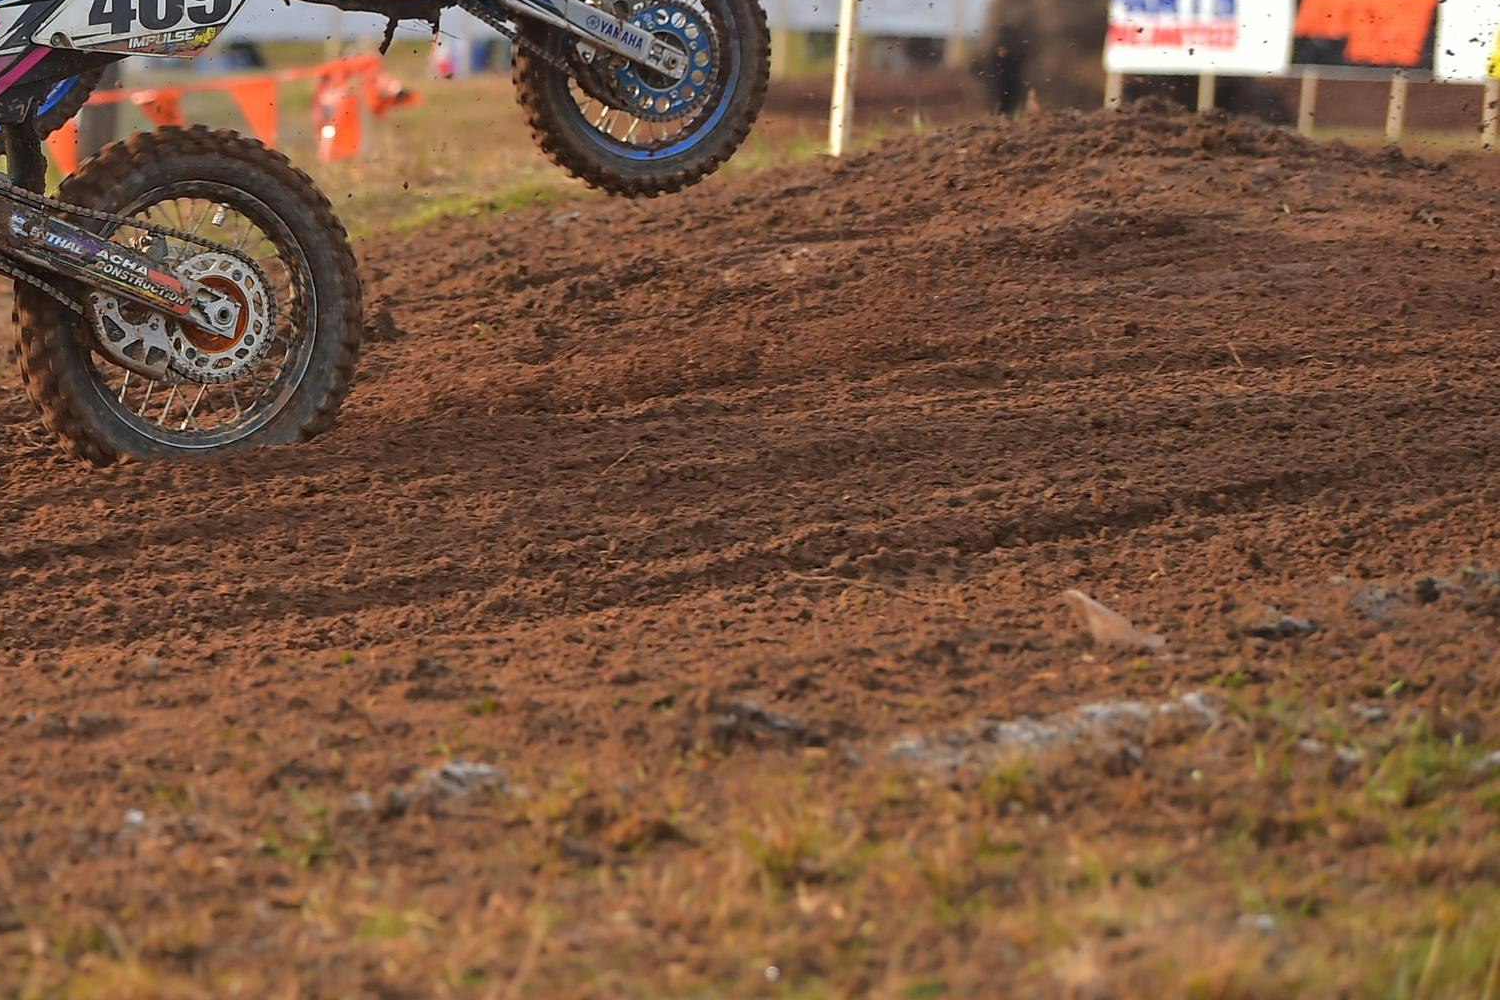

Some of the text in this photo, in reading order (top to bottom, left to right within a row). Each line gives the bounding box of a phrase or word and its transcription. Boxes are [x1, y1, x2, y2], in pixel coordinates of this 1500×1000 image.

[128, 28, 197, 49] IMPULSE
[600, 20, 643, 51] YAMAHA
[94, 260, 187, 305] CONSTRUCTION
